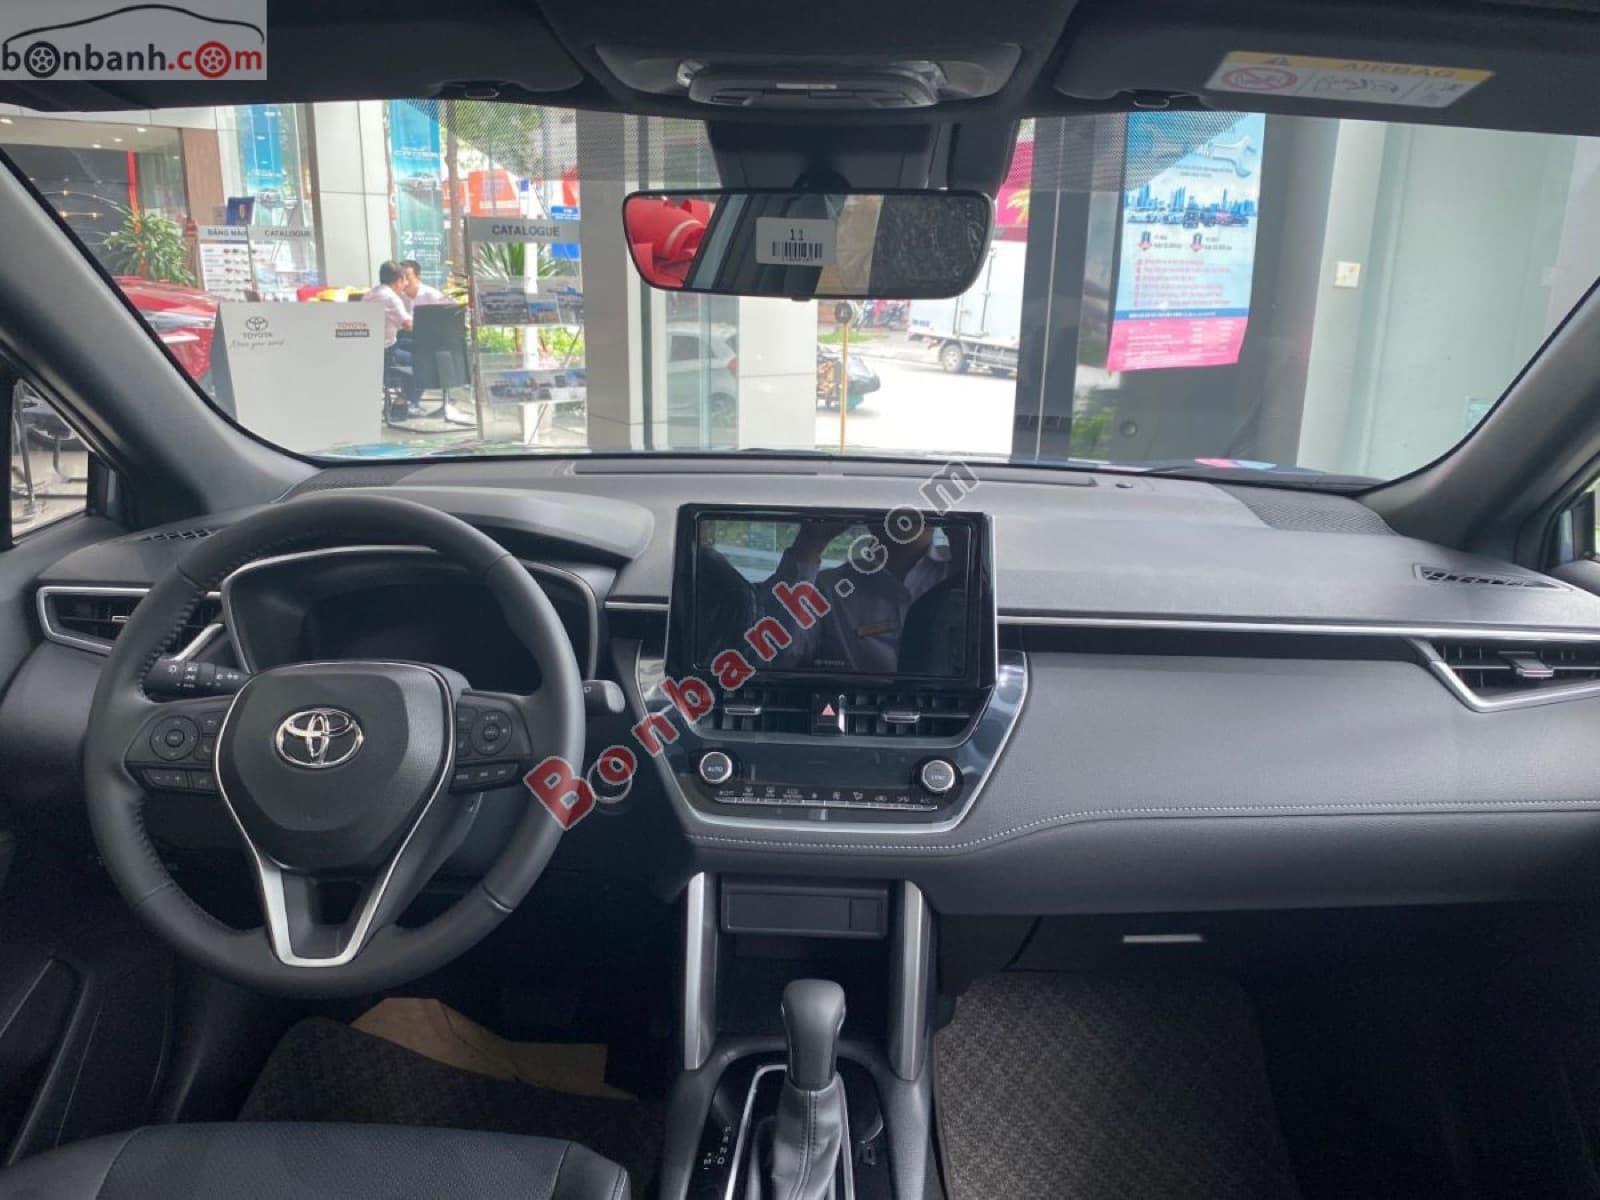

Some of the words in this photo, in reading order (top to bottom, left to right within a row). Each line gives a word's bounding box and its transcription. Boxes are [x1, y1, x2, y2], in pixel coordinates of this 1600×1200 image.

[1342, 63, 1456, 78] AIRBAG
[264, 229, 312, 238] CATALOGUE
[491, 224, 561, 238] CATALOGUE
[403, 231, 414, 245] 2
[337, 321, 368, 329] TOYOTA
[242, 332, 273, 340] TOYOTA
